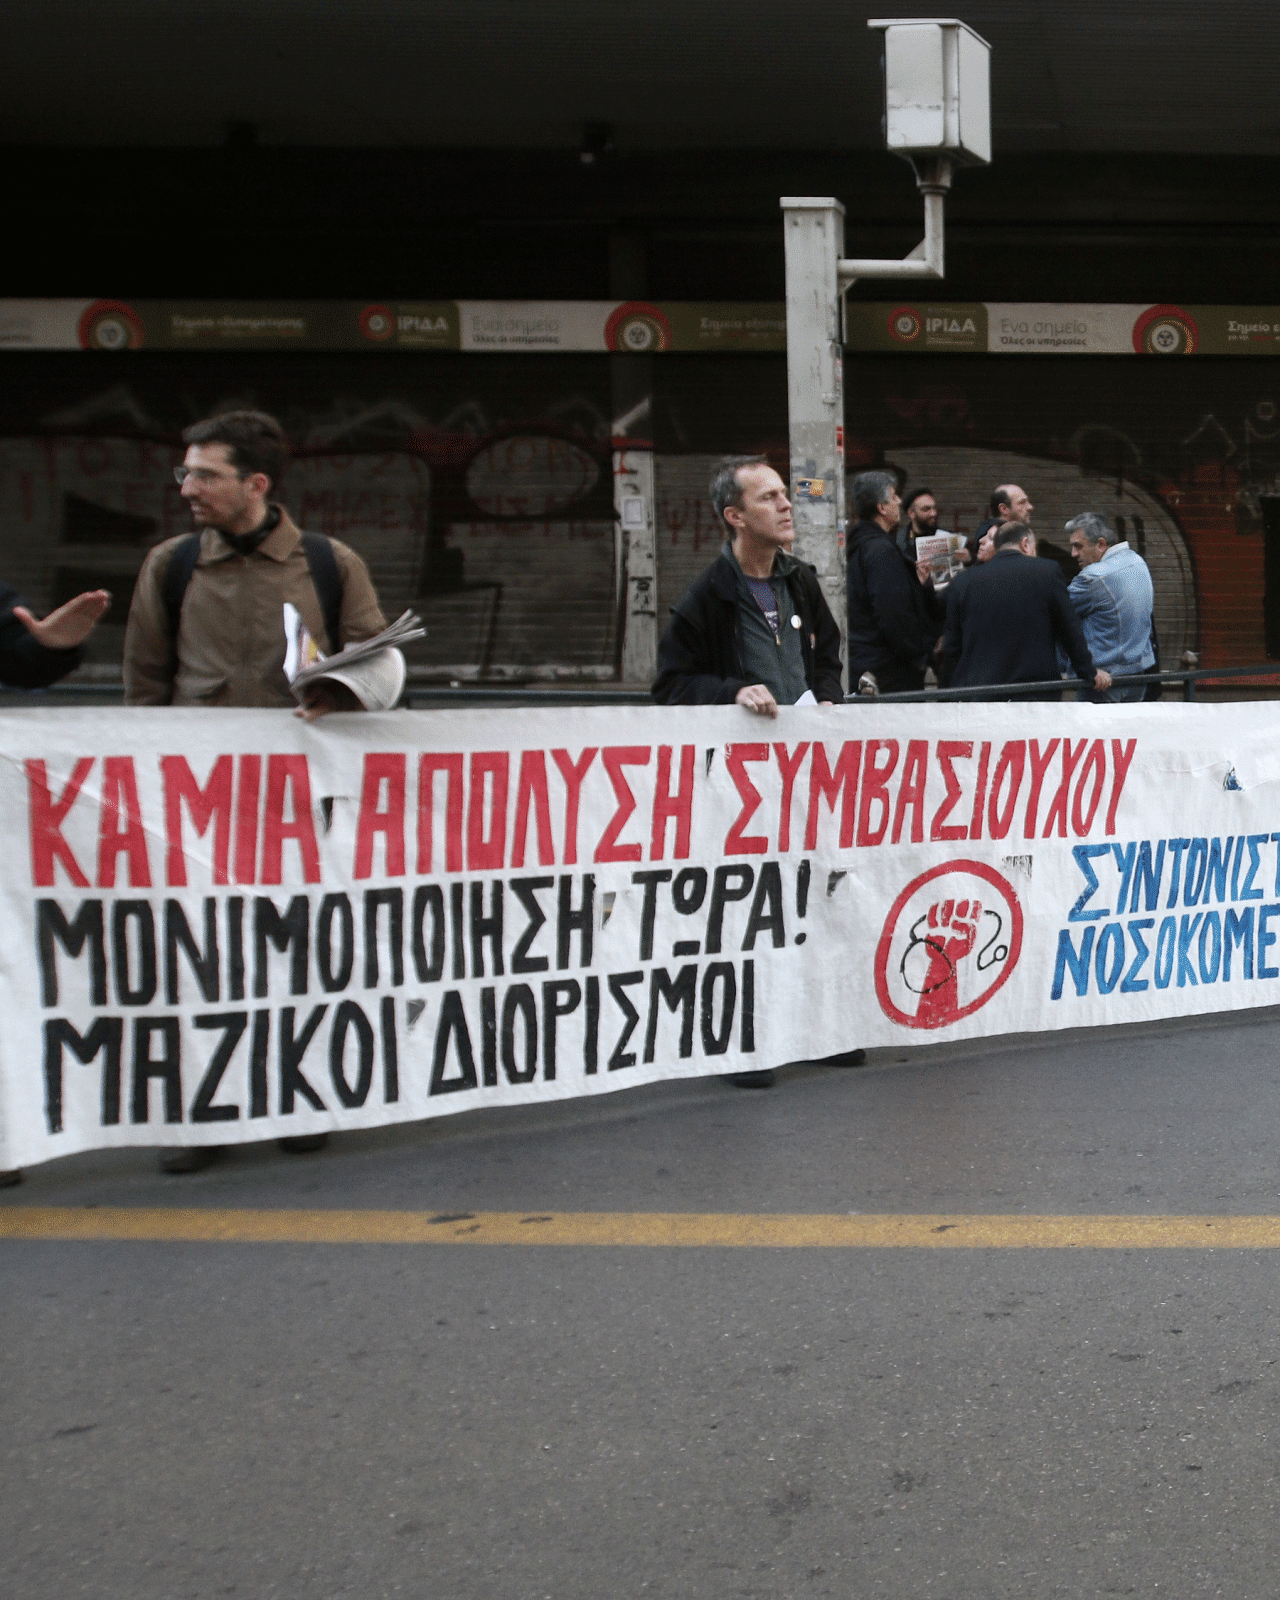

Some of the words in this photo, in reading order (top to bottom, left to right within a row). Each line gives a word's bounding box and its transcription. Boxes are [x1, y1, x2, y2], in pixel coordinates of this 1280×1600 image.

[398, 316, 449, 331] ΙΡΙΔΑ
[926, 317, 976, 332] ΙΡΙΔΑ
[1000, 318, 1029, 333] Ένα
[1033, 319, 1088, 336] σημείο
[1228, 320, 1270, 335] Σημείο
[1038, 336, 1088, 347] υπηρεσίες
[23, 753, 321, 889] ΚΑΜΙΑ
[352, 743, 696, 880] ΑΠΟΛΥΣΗ
[723, 737, 1137, 856] ΣΥΜΒΑΣΙΟΥΧΟΥ
[34, 873, 595, 1009] ΜΟΝΙΜΟΠΟΙΗΣΗ
[43, 995, 399, 1136] ΜΑΖΙΚΟΙ
[427, 958, 756, 1097] ΔΙΟΡΙΣΜΟΙ
